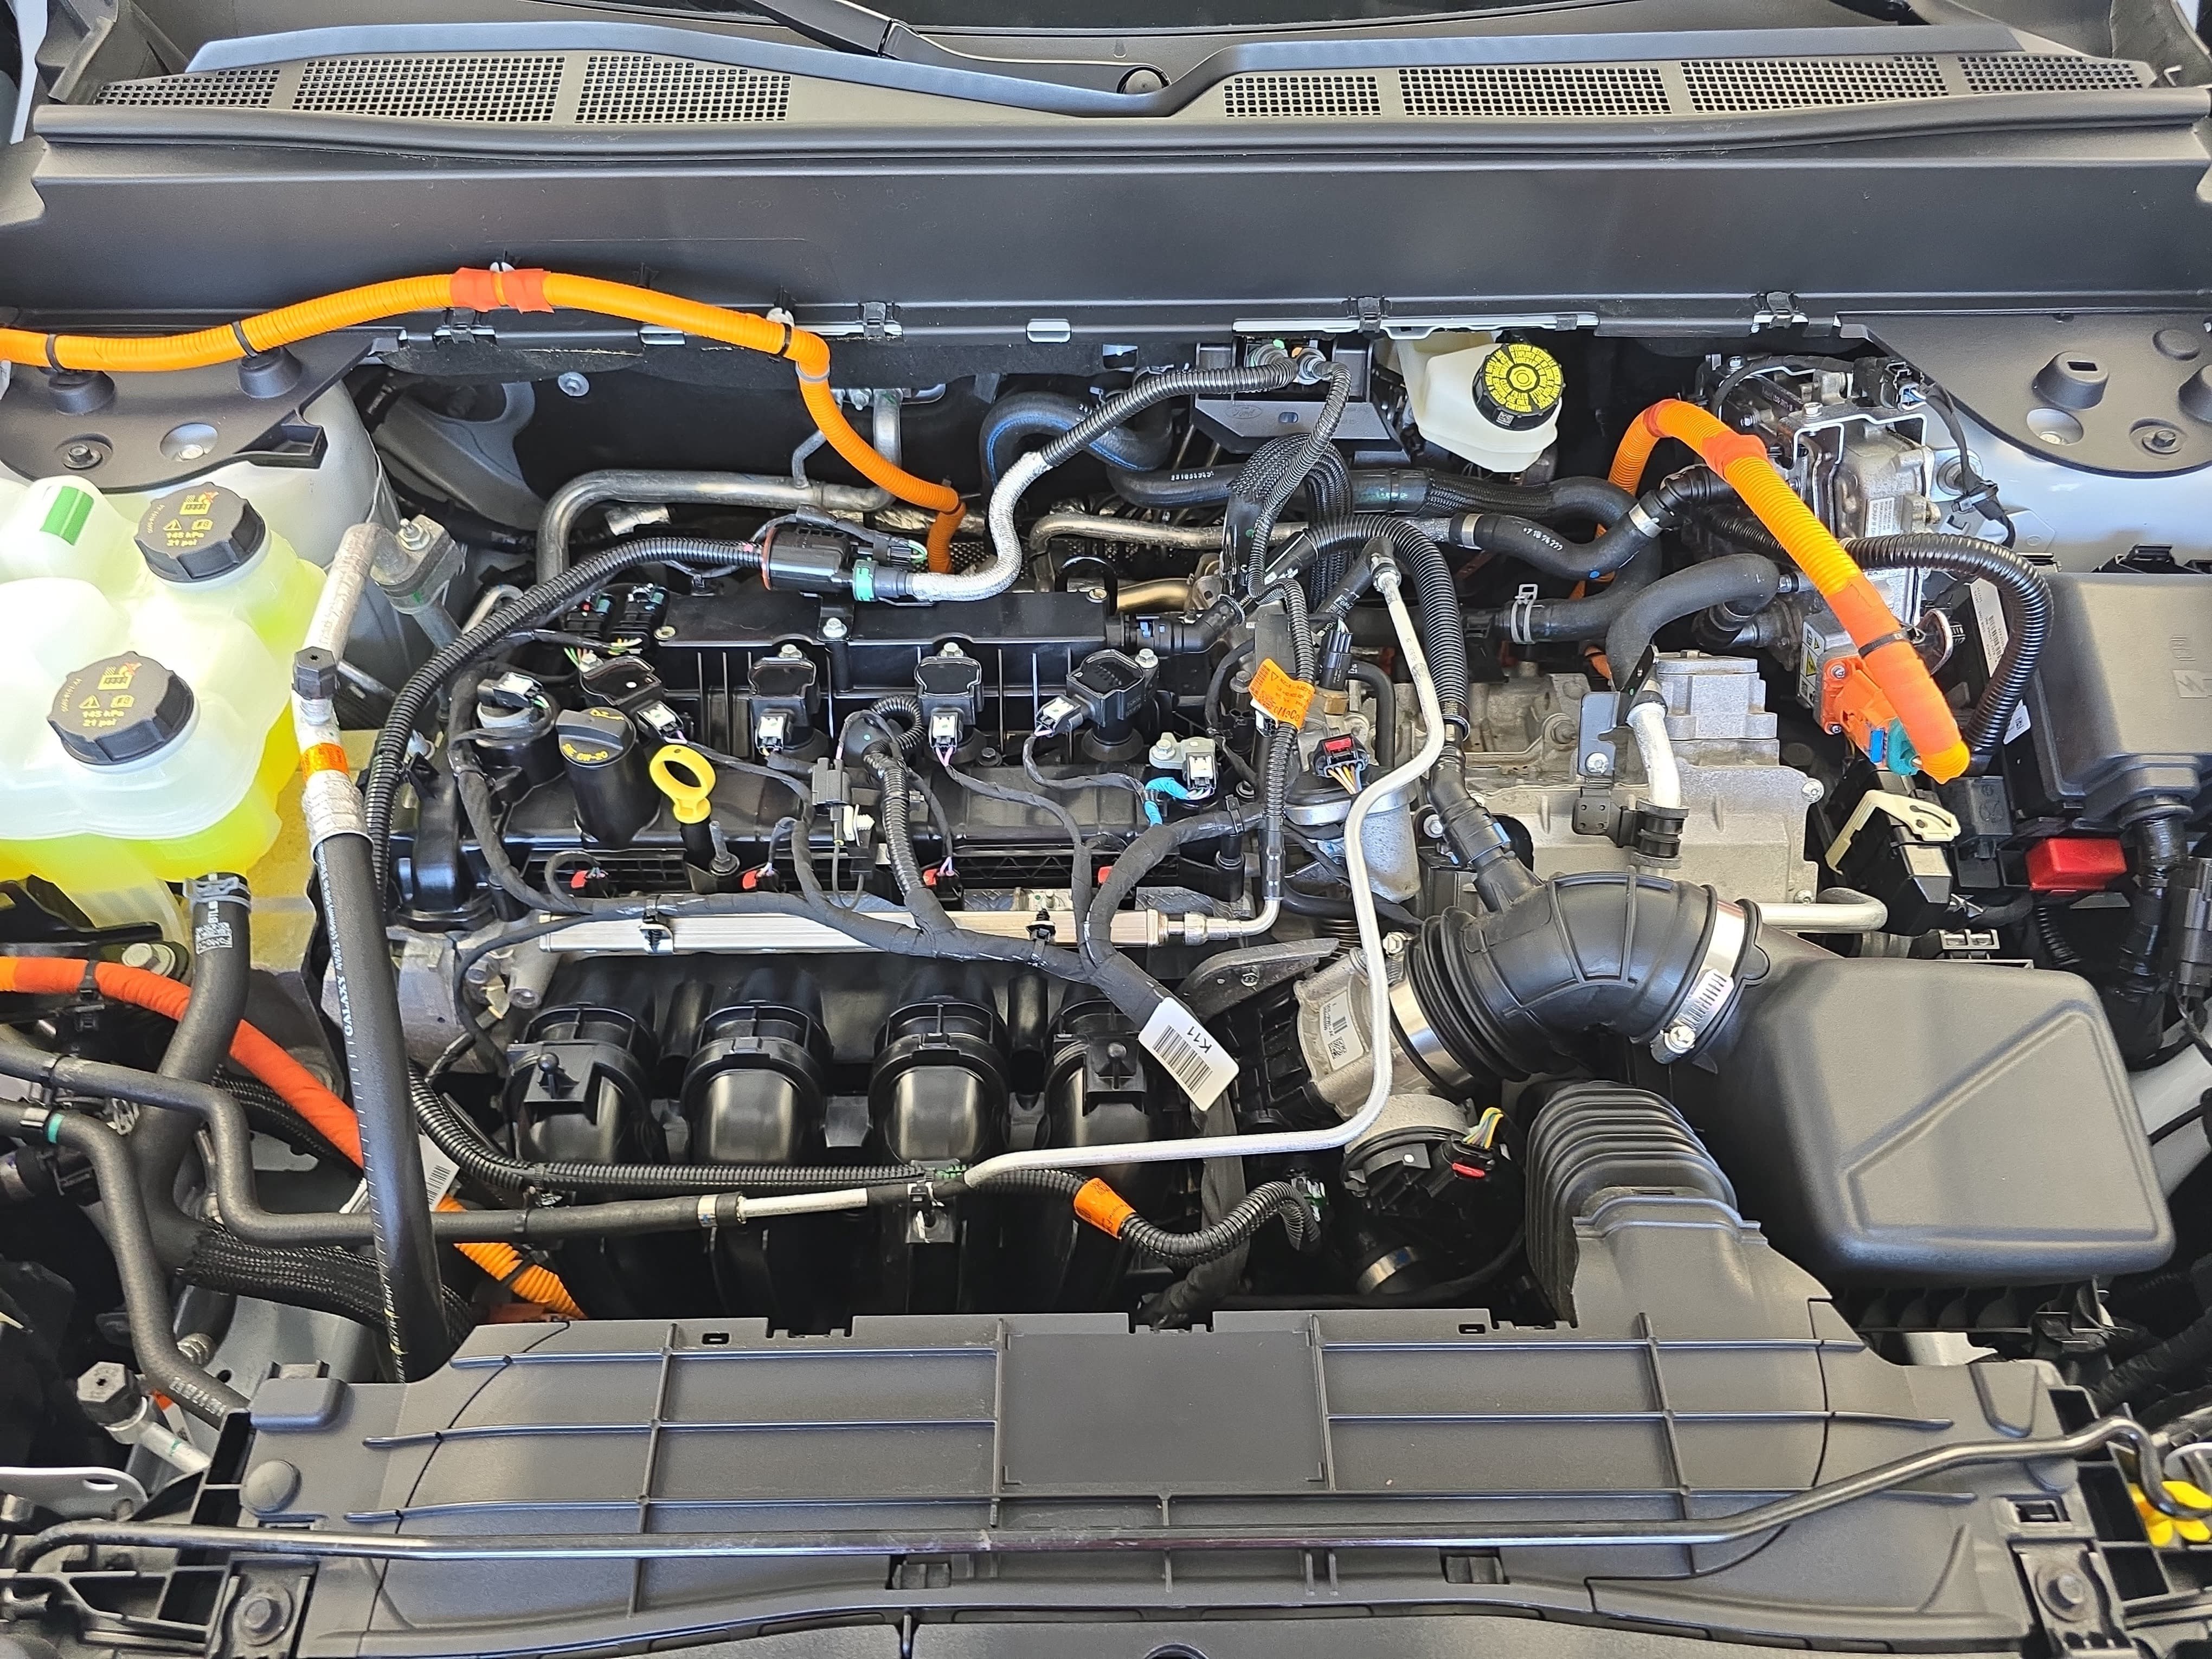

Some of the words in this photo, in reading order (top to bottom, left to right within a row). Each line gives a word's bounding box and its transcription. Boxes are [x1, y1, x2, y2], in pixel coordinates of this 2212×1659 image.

[1506, 401, 1532, 412] CONTAINER
[576, 750, 608, 762] 0W-20
[1187, 1026, 1212, 1054] K11
